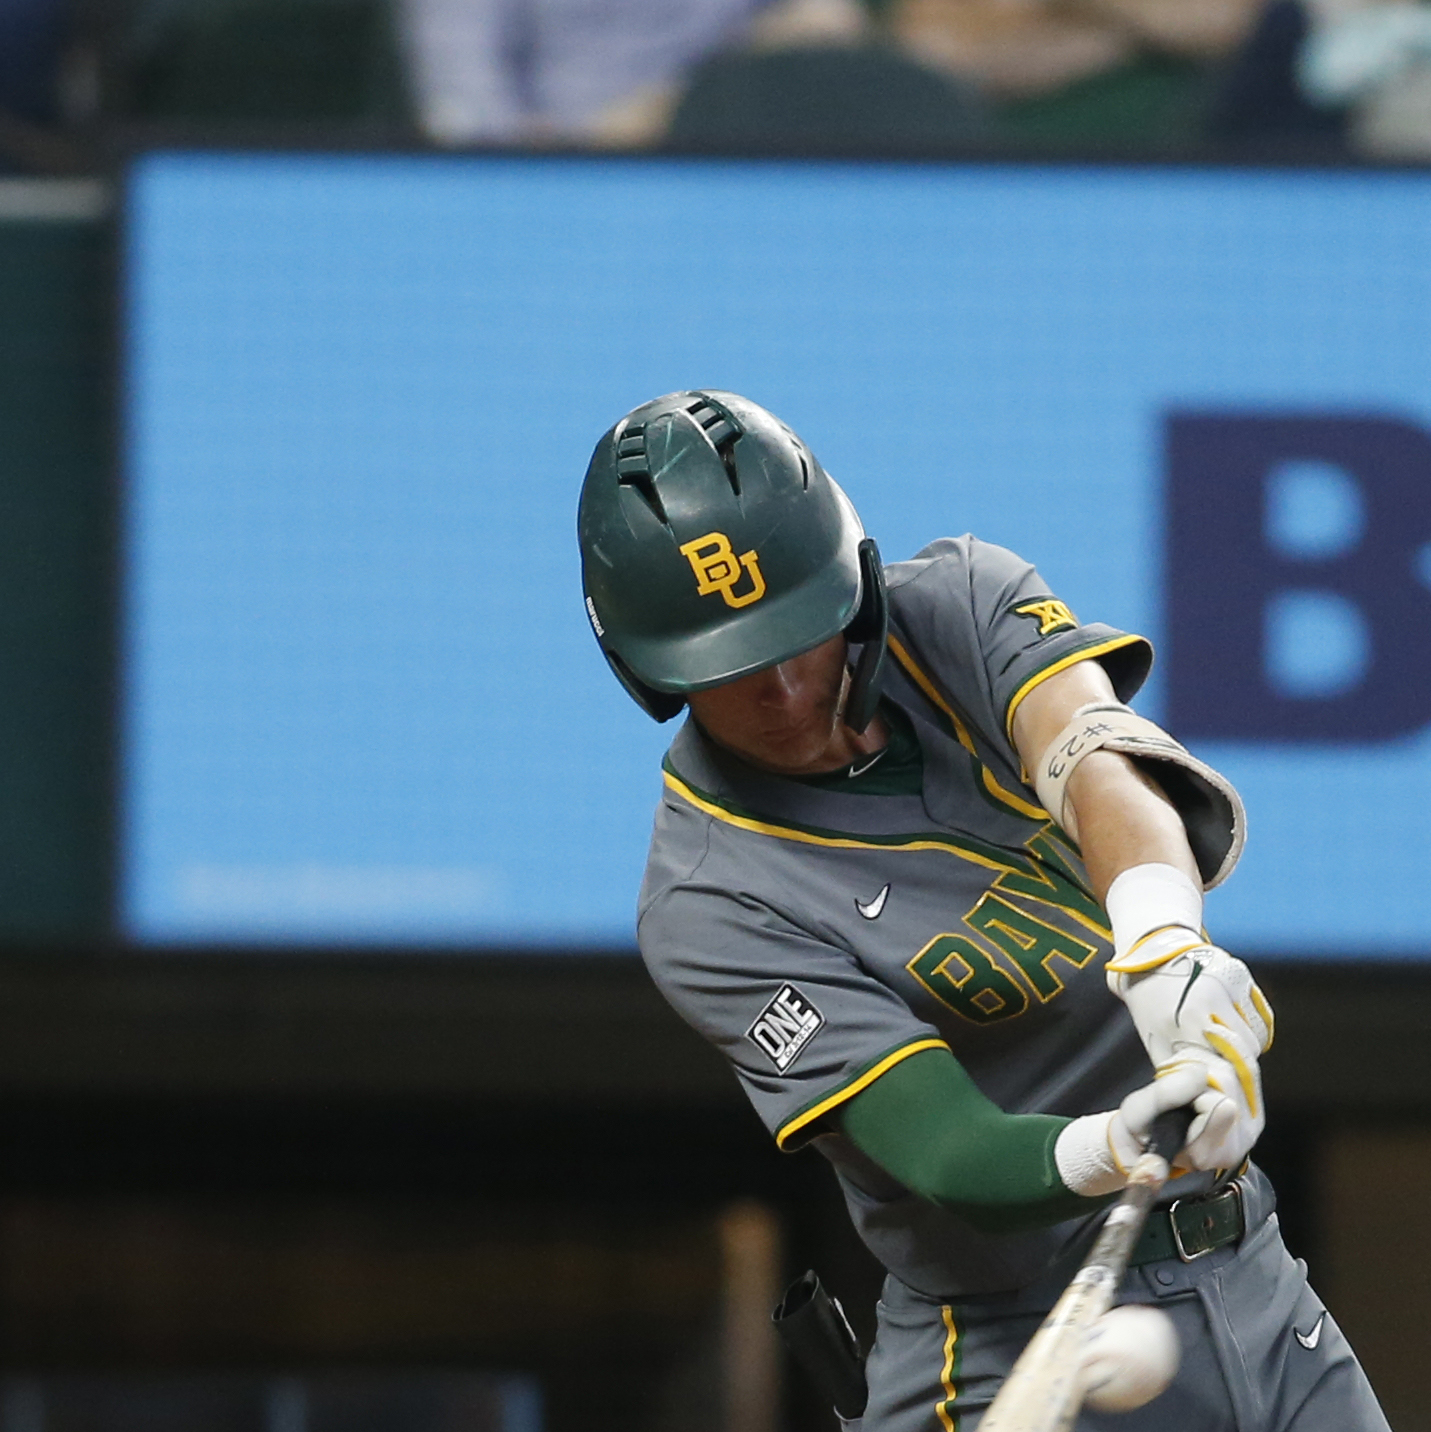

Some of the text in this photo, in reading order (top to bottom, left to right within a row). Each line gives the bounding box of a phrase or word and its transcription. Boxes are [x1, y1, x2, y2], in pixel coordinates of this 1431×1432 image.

[679, 531, 766, 608] BU
[585, 596, 605, 637] marucci
[1048, 723, 1113, 779] #23
[753, 987, 813, 1058] ONE
